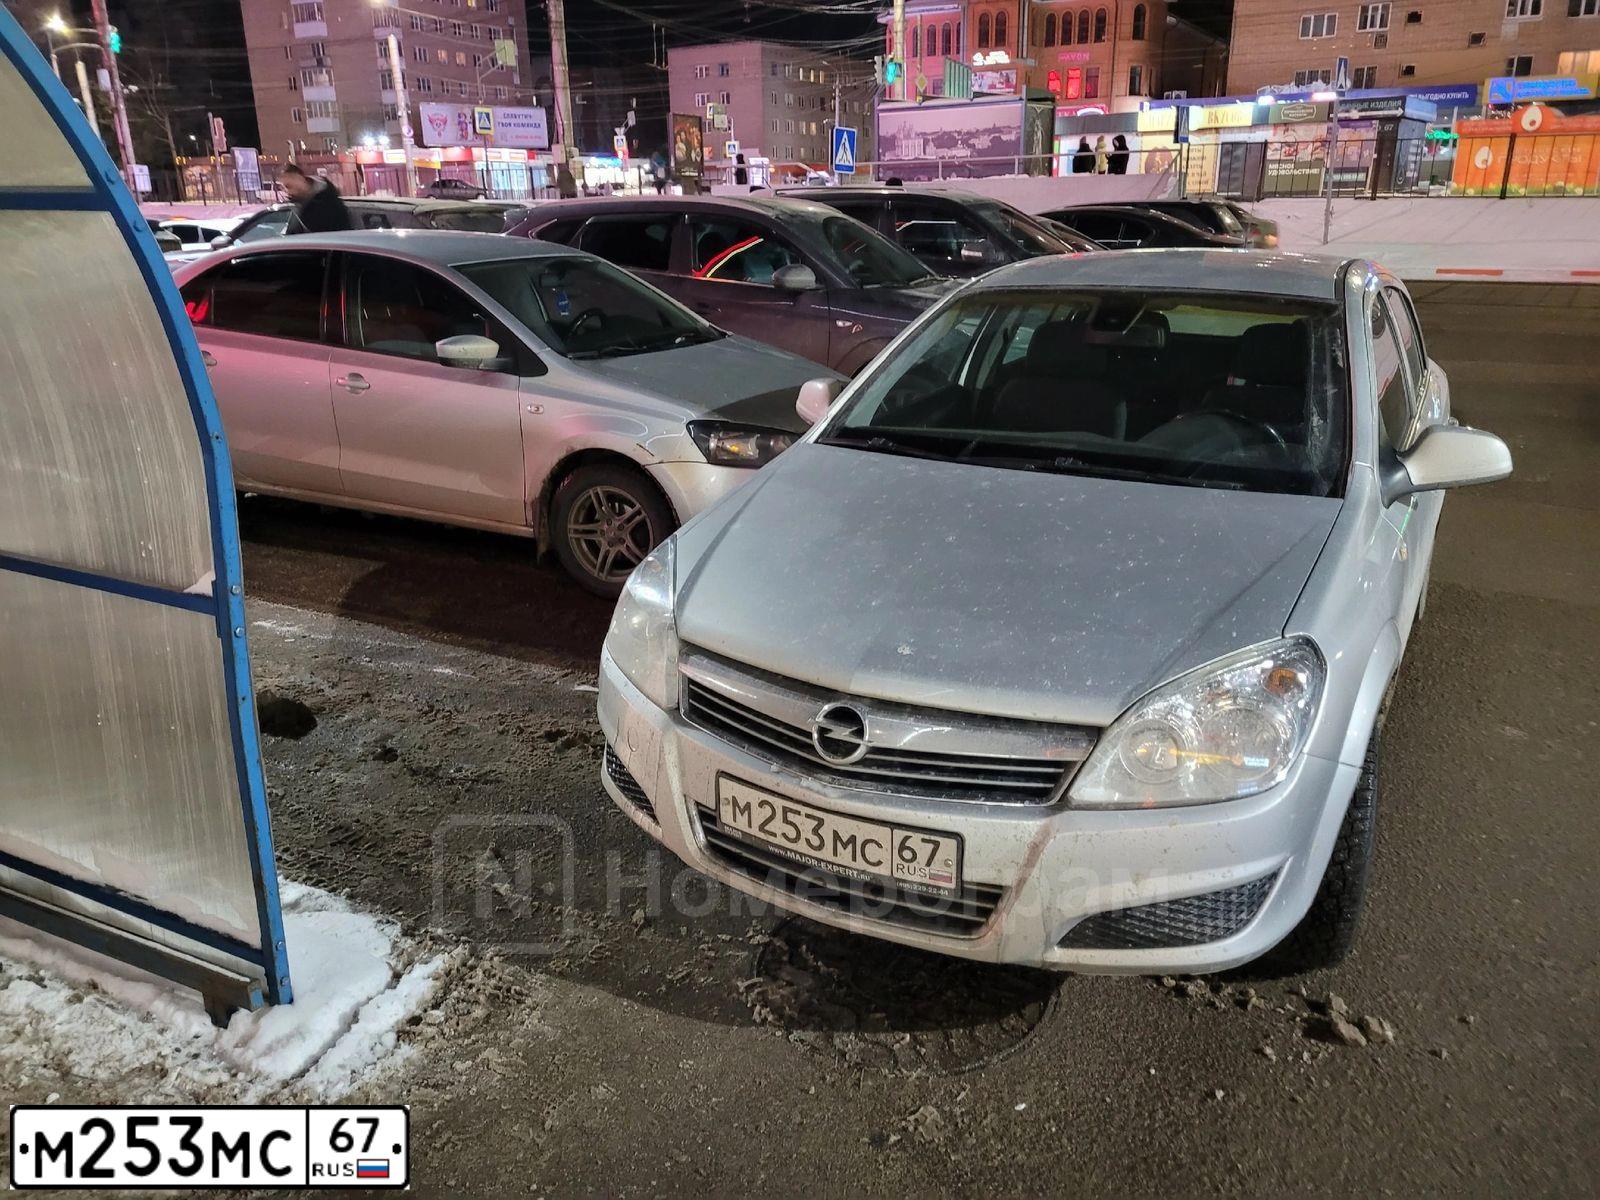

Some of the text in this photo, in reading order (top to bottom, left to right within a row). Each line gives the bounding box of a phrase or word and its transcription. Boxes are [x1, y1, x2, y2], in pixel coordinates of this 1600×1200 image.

[731, 796, 884, 868] М253МС
[897, 835, 941, 868] 67
[896, 863, 928, 879] RUS
